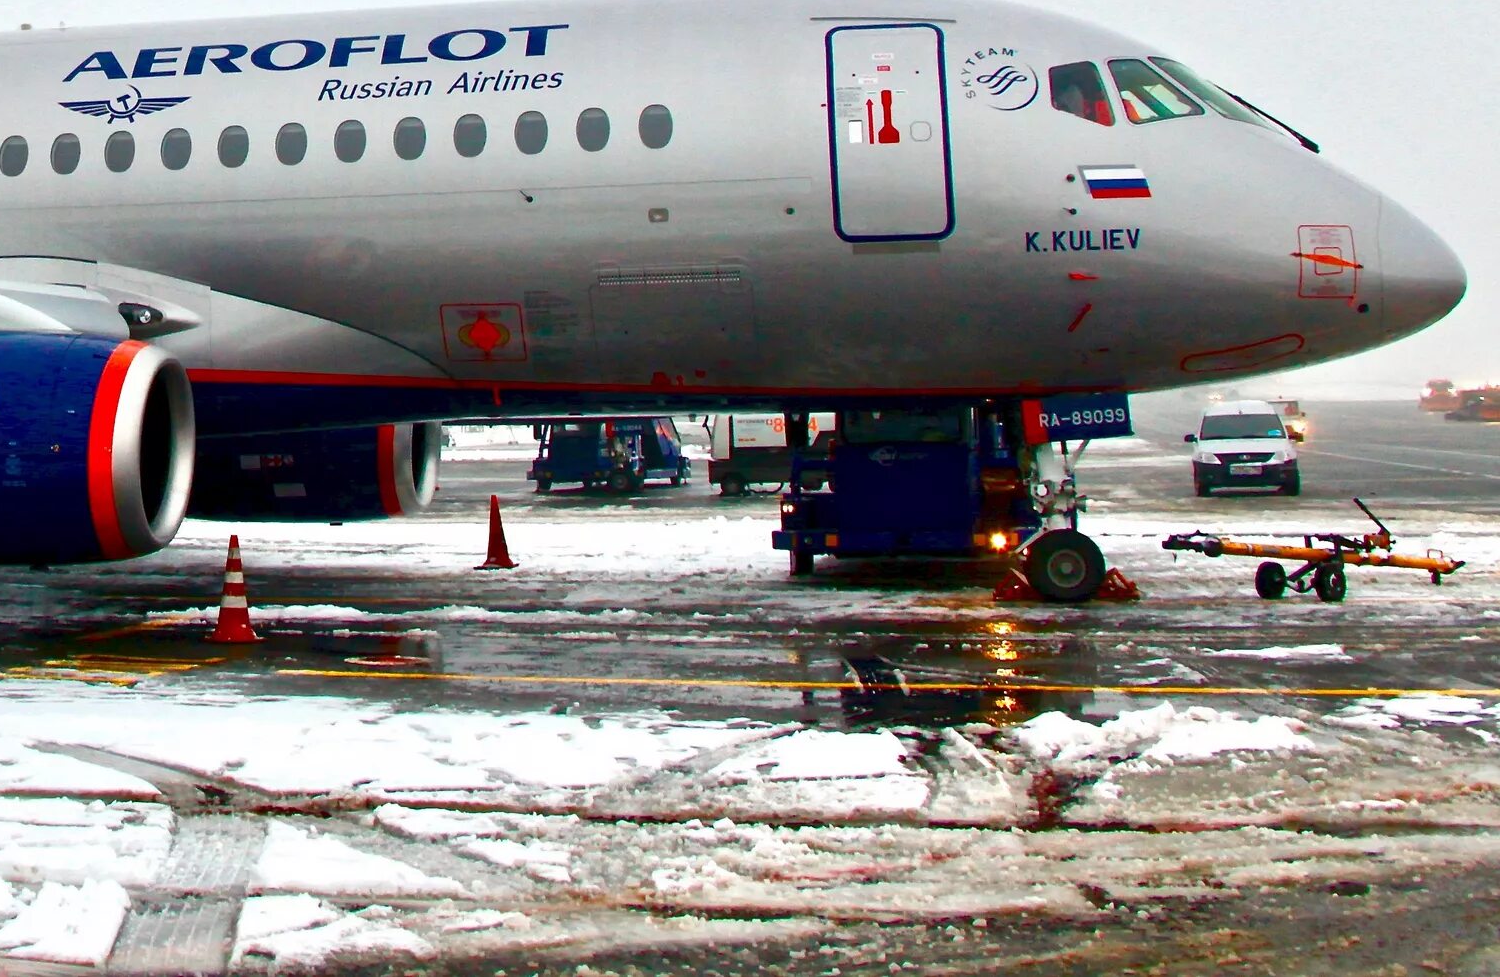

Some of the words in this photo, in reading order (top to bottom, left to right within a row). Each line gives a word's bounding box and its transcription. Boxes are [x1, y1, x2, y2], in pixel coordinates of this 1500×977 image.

[62, 24, 570, 82] AEROFLOT
[318, 76, 433, 101] Russian
[447, 70, 564, 95] Airlines
[961, 48, 1015, 99] SKYTEAM
[1025, 228, 1140, 253] K.KULIEV
[1038, 408, 1126, 428] RA-89099
